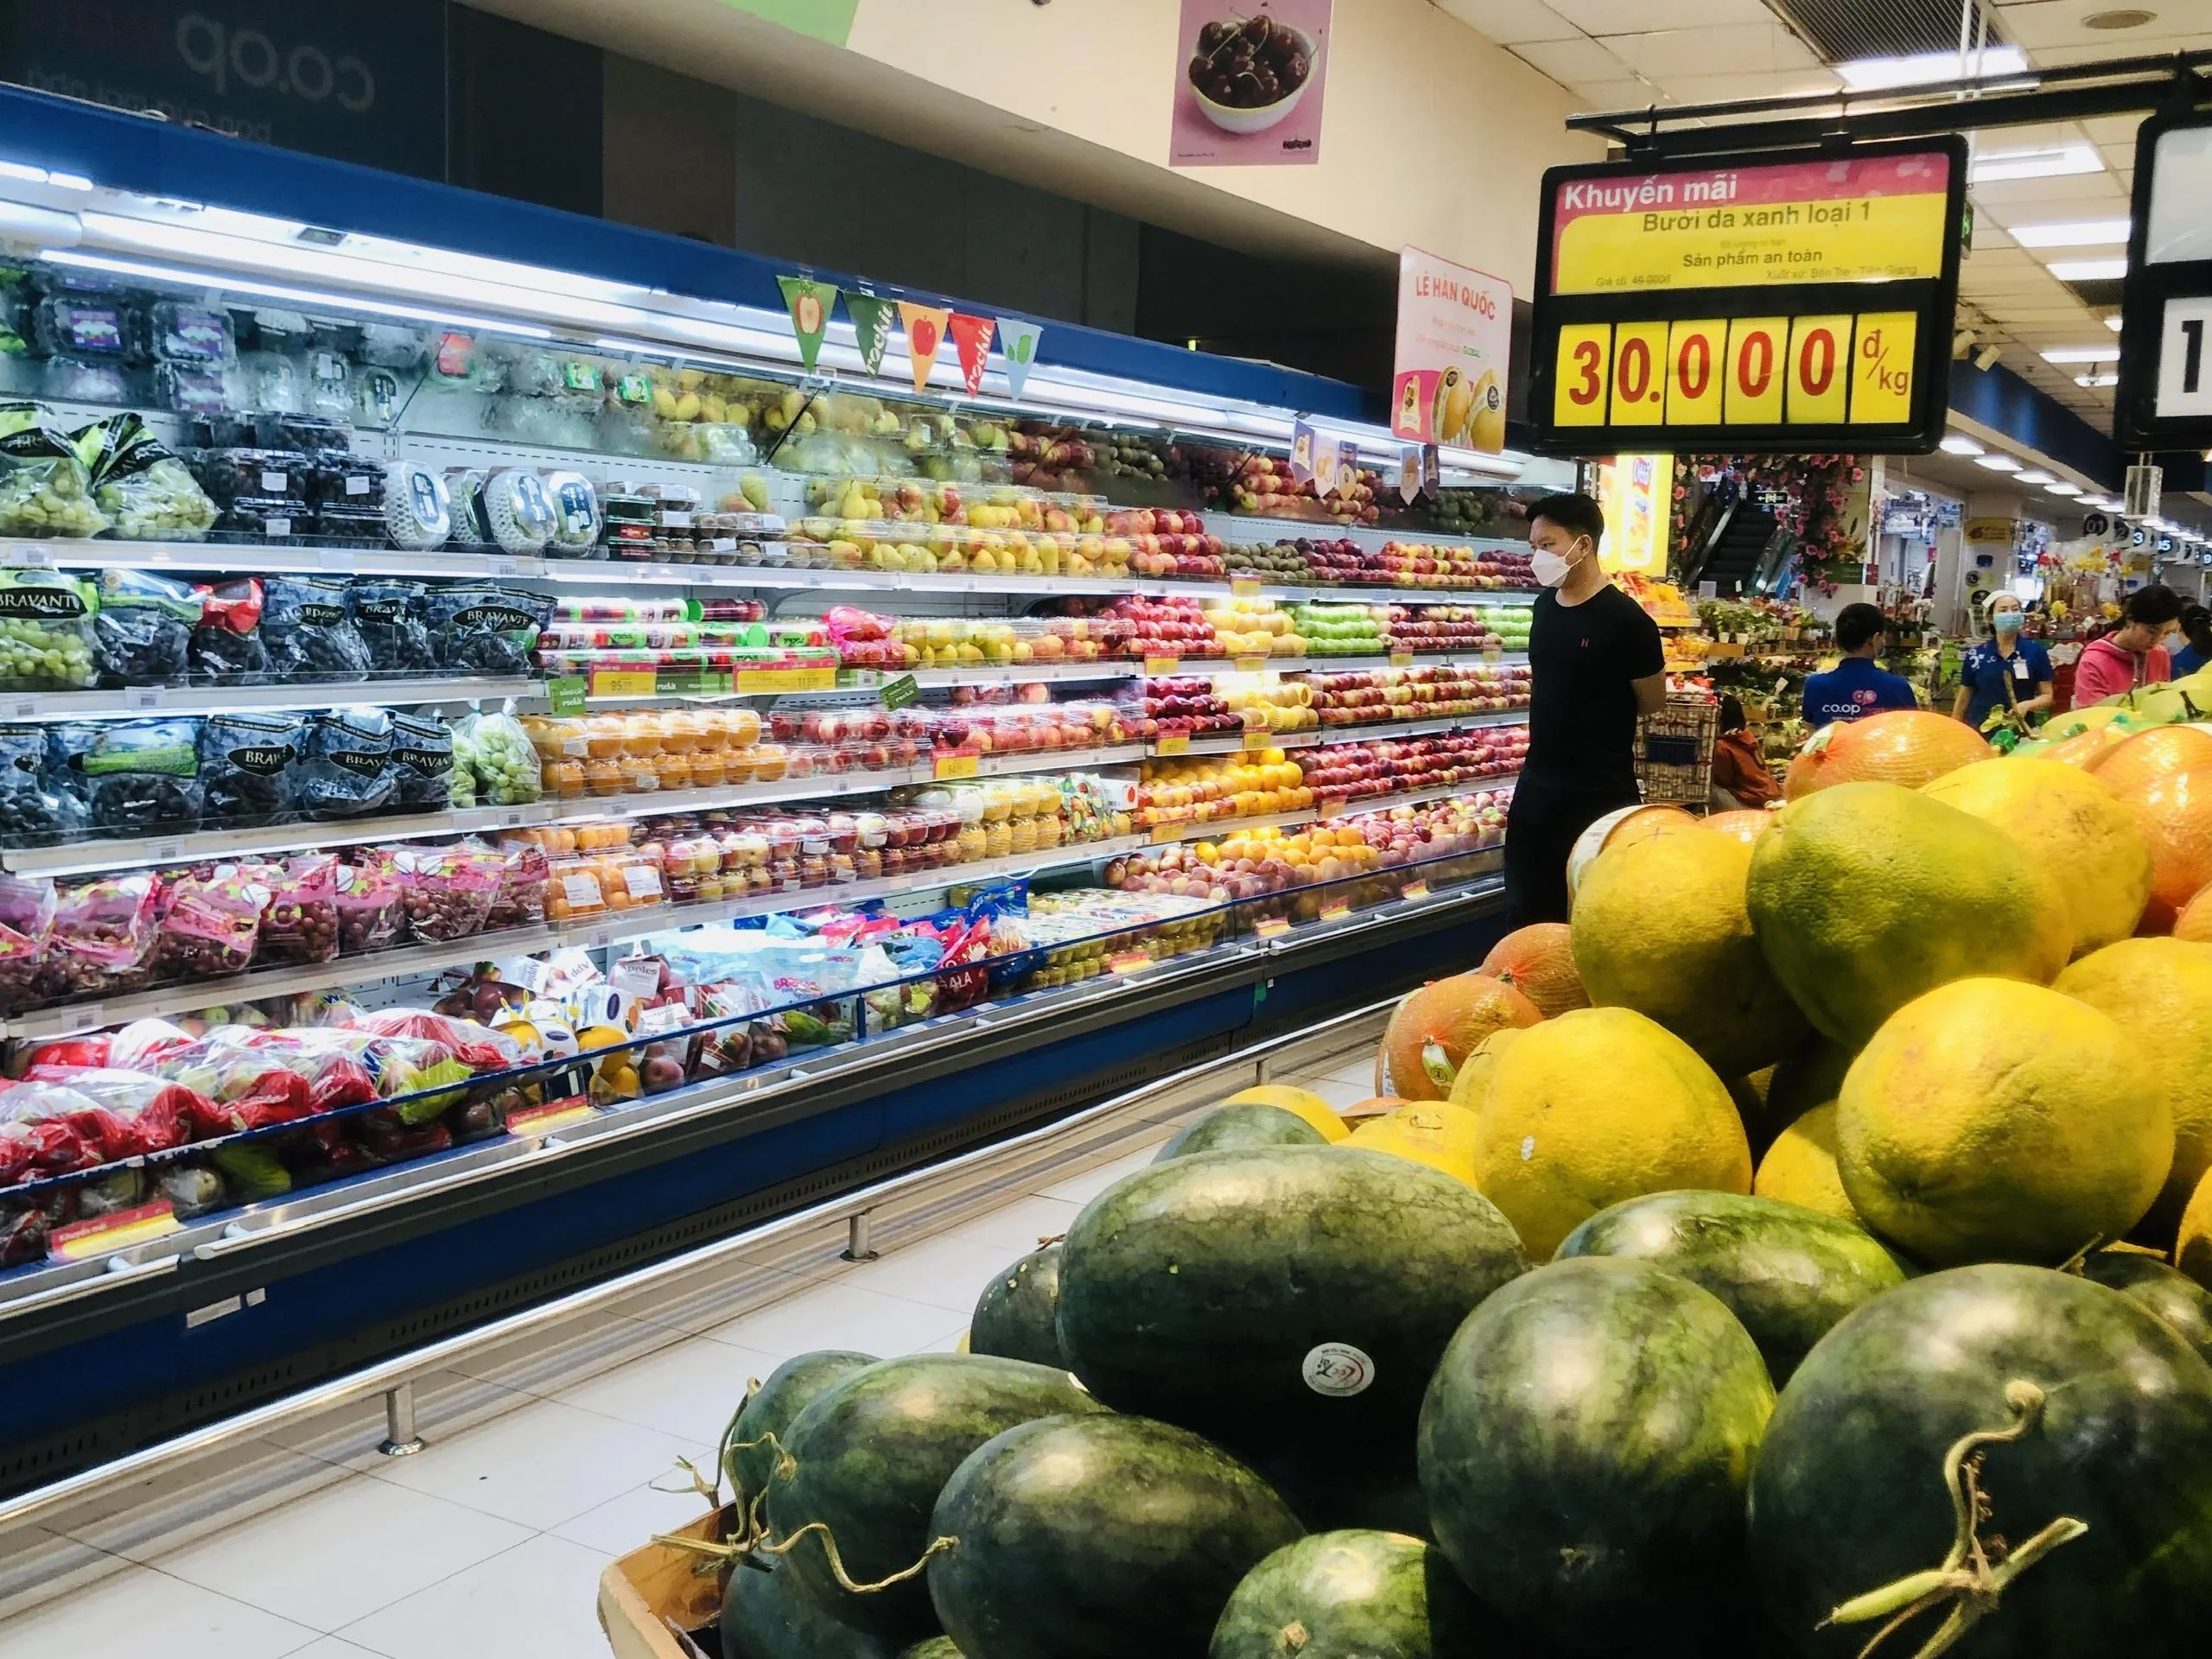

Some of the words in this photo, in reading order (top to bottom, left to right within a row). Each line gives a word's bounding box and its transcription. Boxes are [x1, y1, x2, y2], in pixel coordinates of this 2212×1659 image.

[1565, 175, 1674, 213] Khuyến
[1683, 173, 1738, 201] mãi
[1643, 209, 1699, 232] Bưởi
[1707, 210, 1735, 228] da
[1742, 206, 1799, 226] xanh
[1808, 201, 1851, 227] loại
[1861, 200, 1871, 220] 1
[1683, 252, 1712, 267] Sản
[1717, 248, 1758, 269] phẩm
[1764, 253, 1786, 264] an
[865, 304, 893, 376] rockit
[967, 325, 993, 391] rockit
[1568, 328, 1835, 405] 30.000
[2182, 320, 2203, 393] 1
